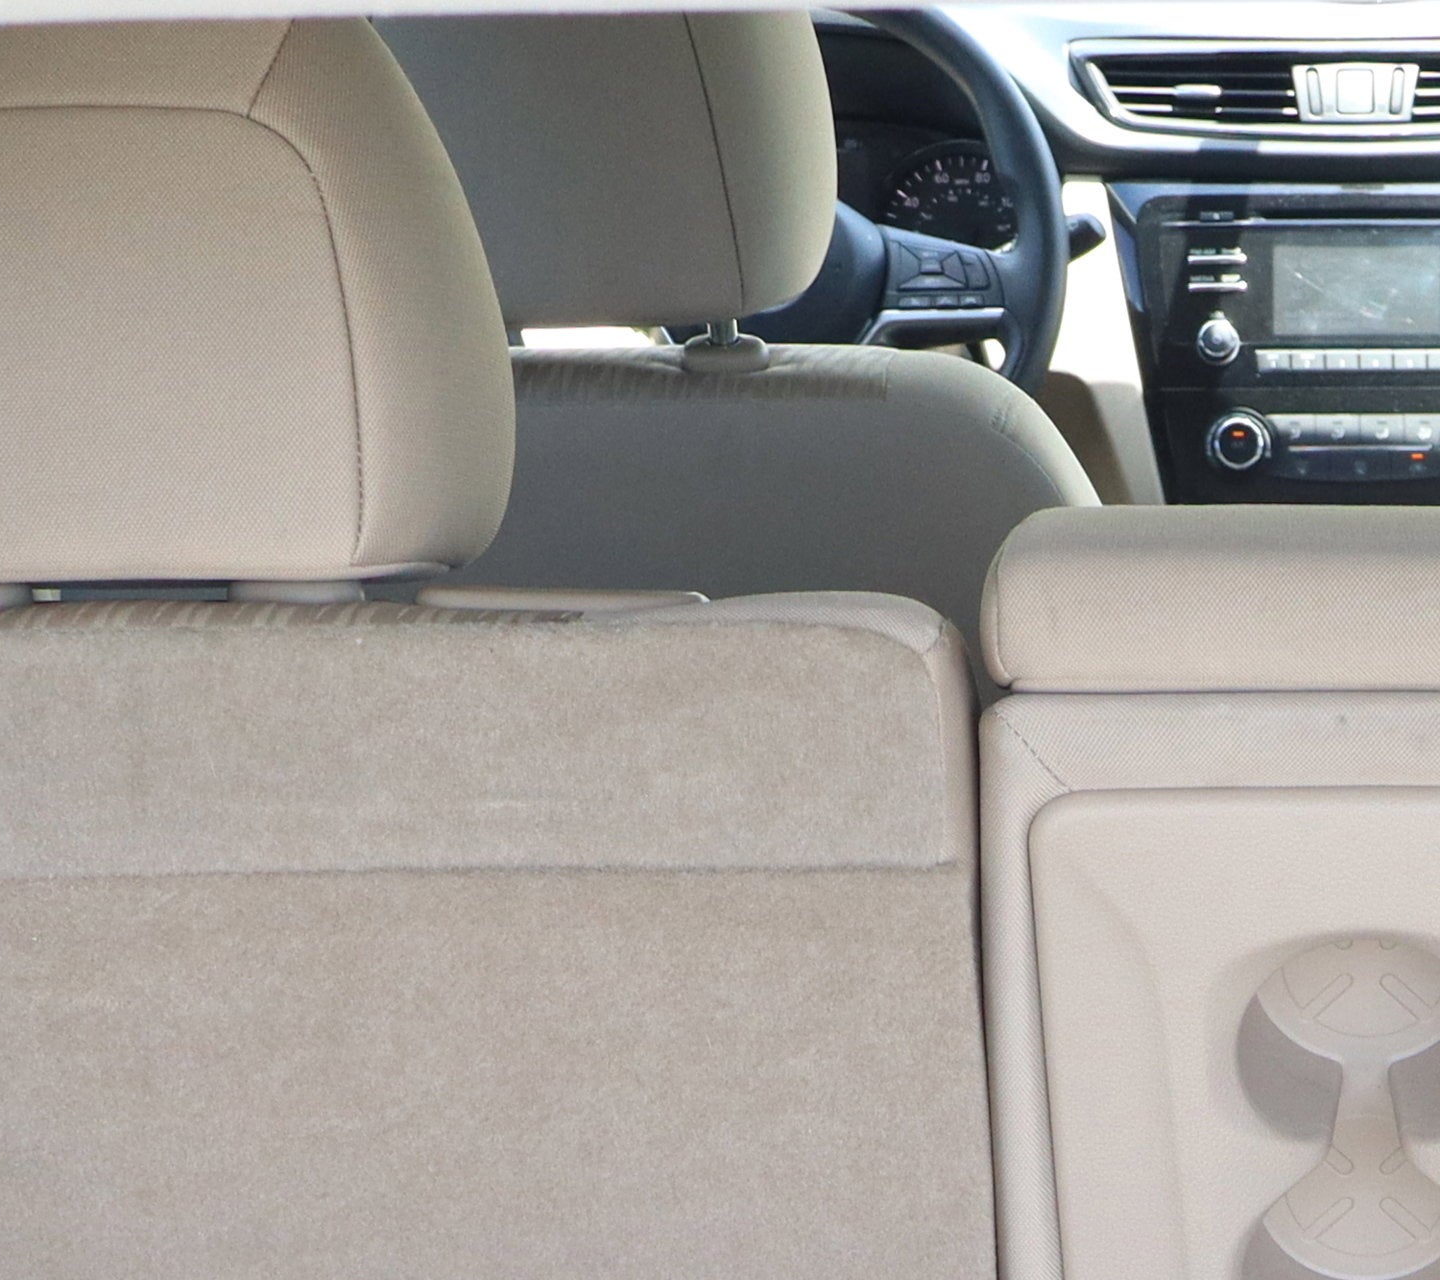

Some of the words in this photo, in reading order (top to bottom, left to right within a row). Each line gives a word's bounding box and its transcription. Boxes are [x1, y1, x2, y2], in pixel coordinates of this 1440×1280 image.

[934, 172, 949, 184] 60
[975, 172, 991, 184] 80
[904, 197, 920, 209] 40
